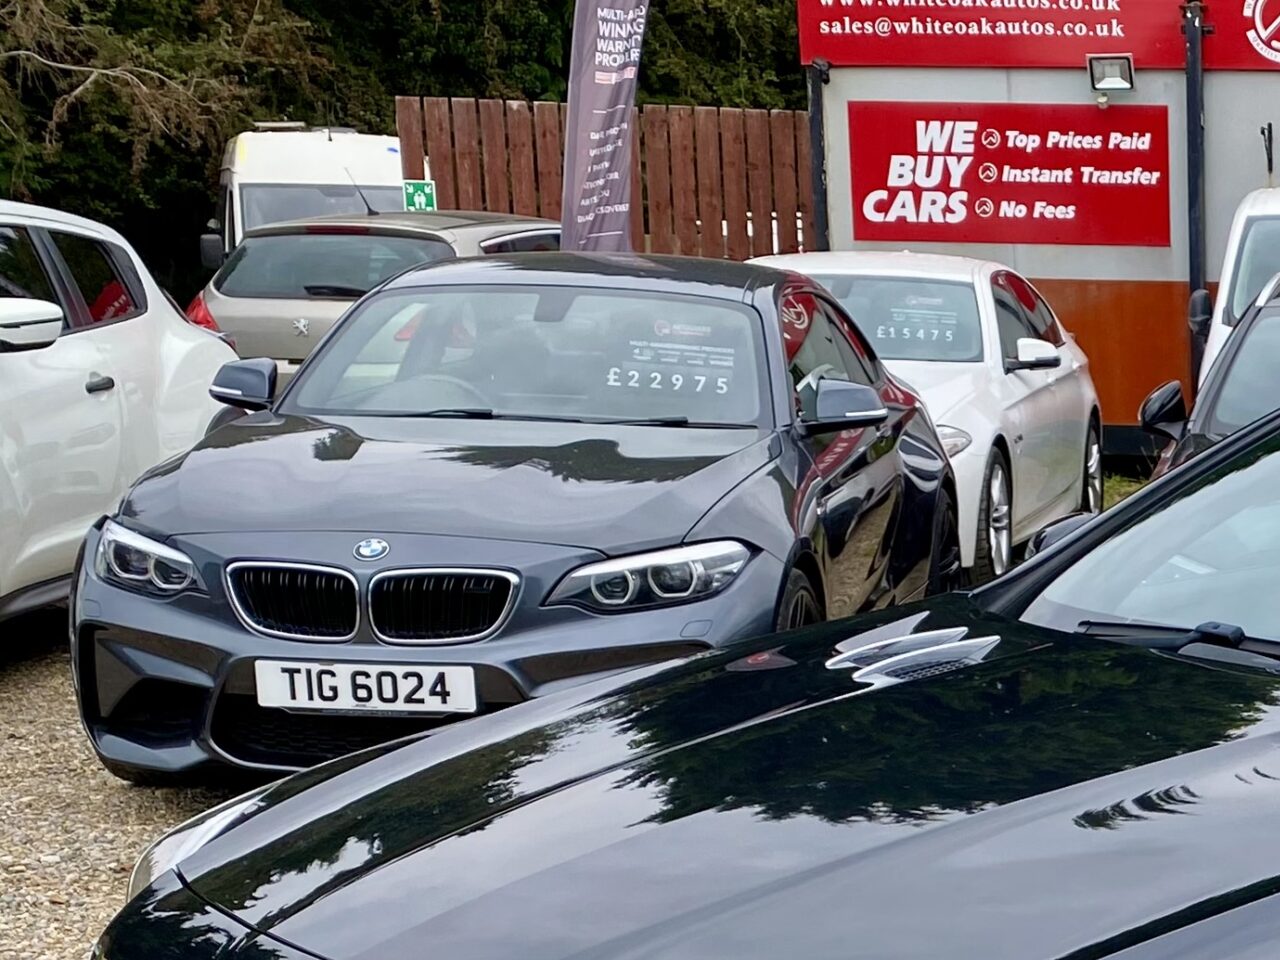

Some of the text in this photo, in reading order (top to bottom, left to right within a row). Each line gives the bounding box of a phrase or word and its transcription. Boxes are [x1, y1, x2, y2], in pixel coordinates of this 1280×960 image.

[819, 16, 1125, 37] sales@whiteoakautos.co.uk
[916, 120, 978, 154] WE
[1005, 130, 1151, 153] Top Prices Paid
[887, 155, 974, 188] BUY
[1002, 165, 1160, 185] Instant Transfer
[862, 189, 968, 223] CARS
[999, 201, 1076, 219] No Fees
[876, 326, 953, 341] £15475
[606, 366, 729, 394] £22975
[280, 667, 451, 705] TIG 6024
